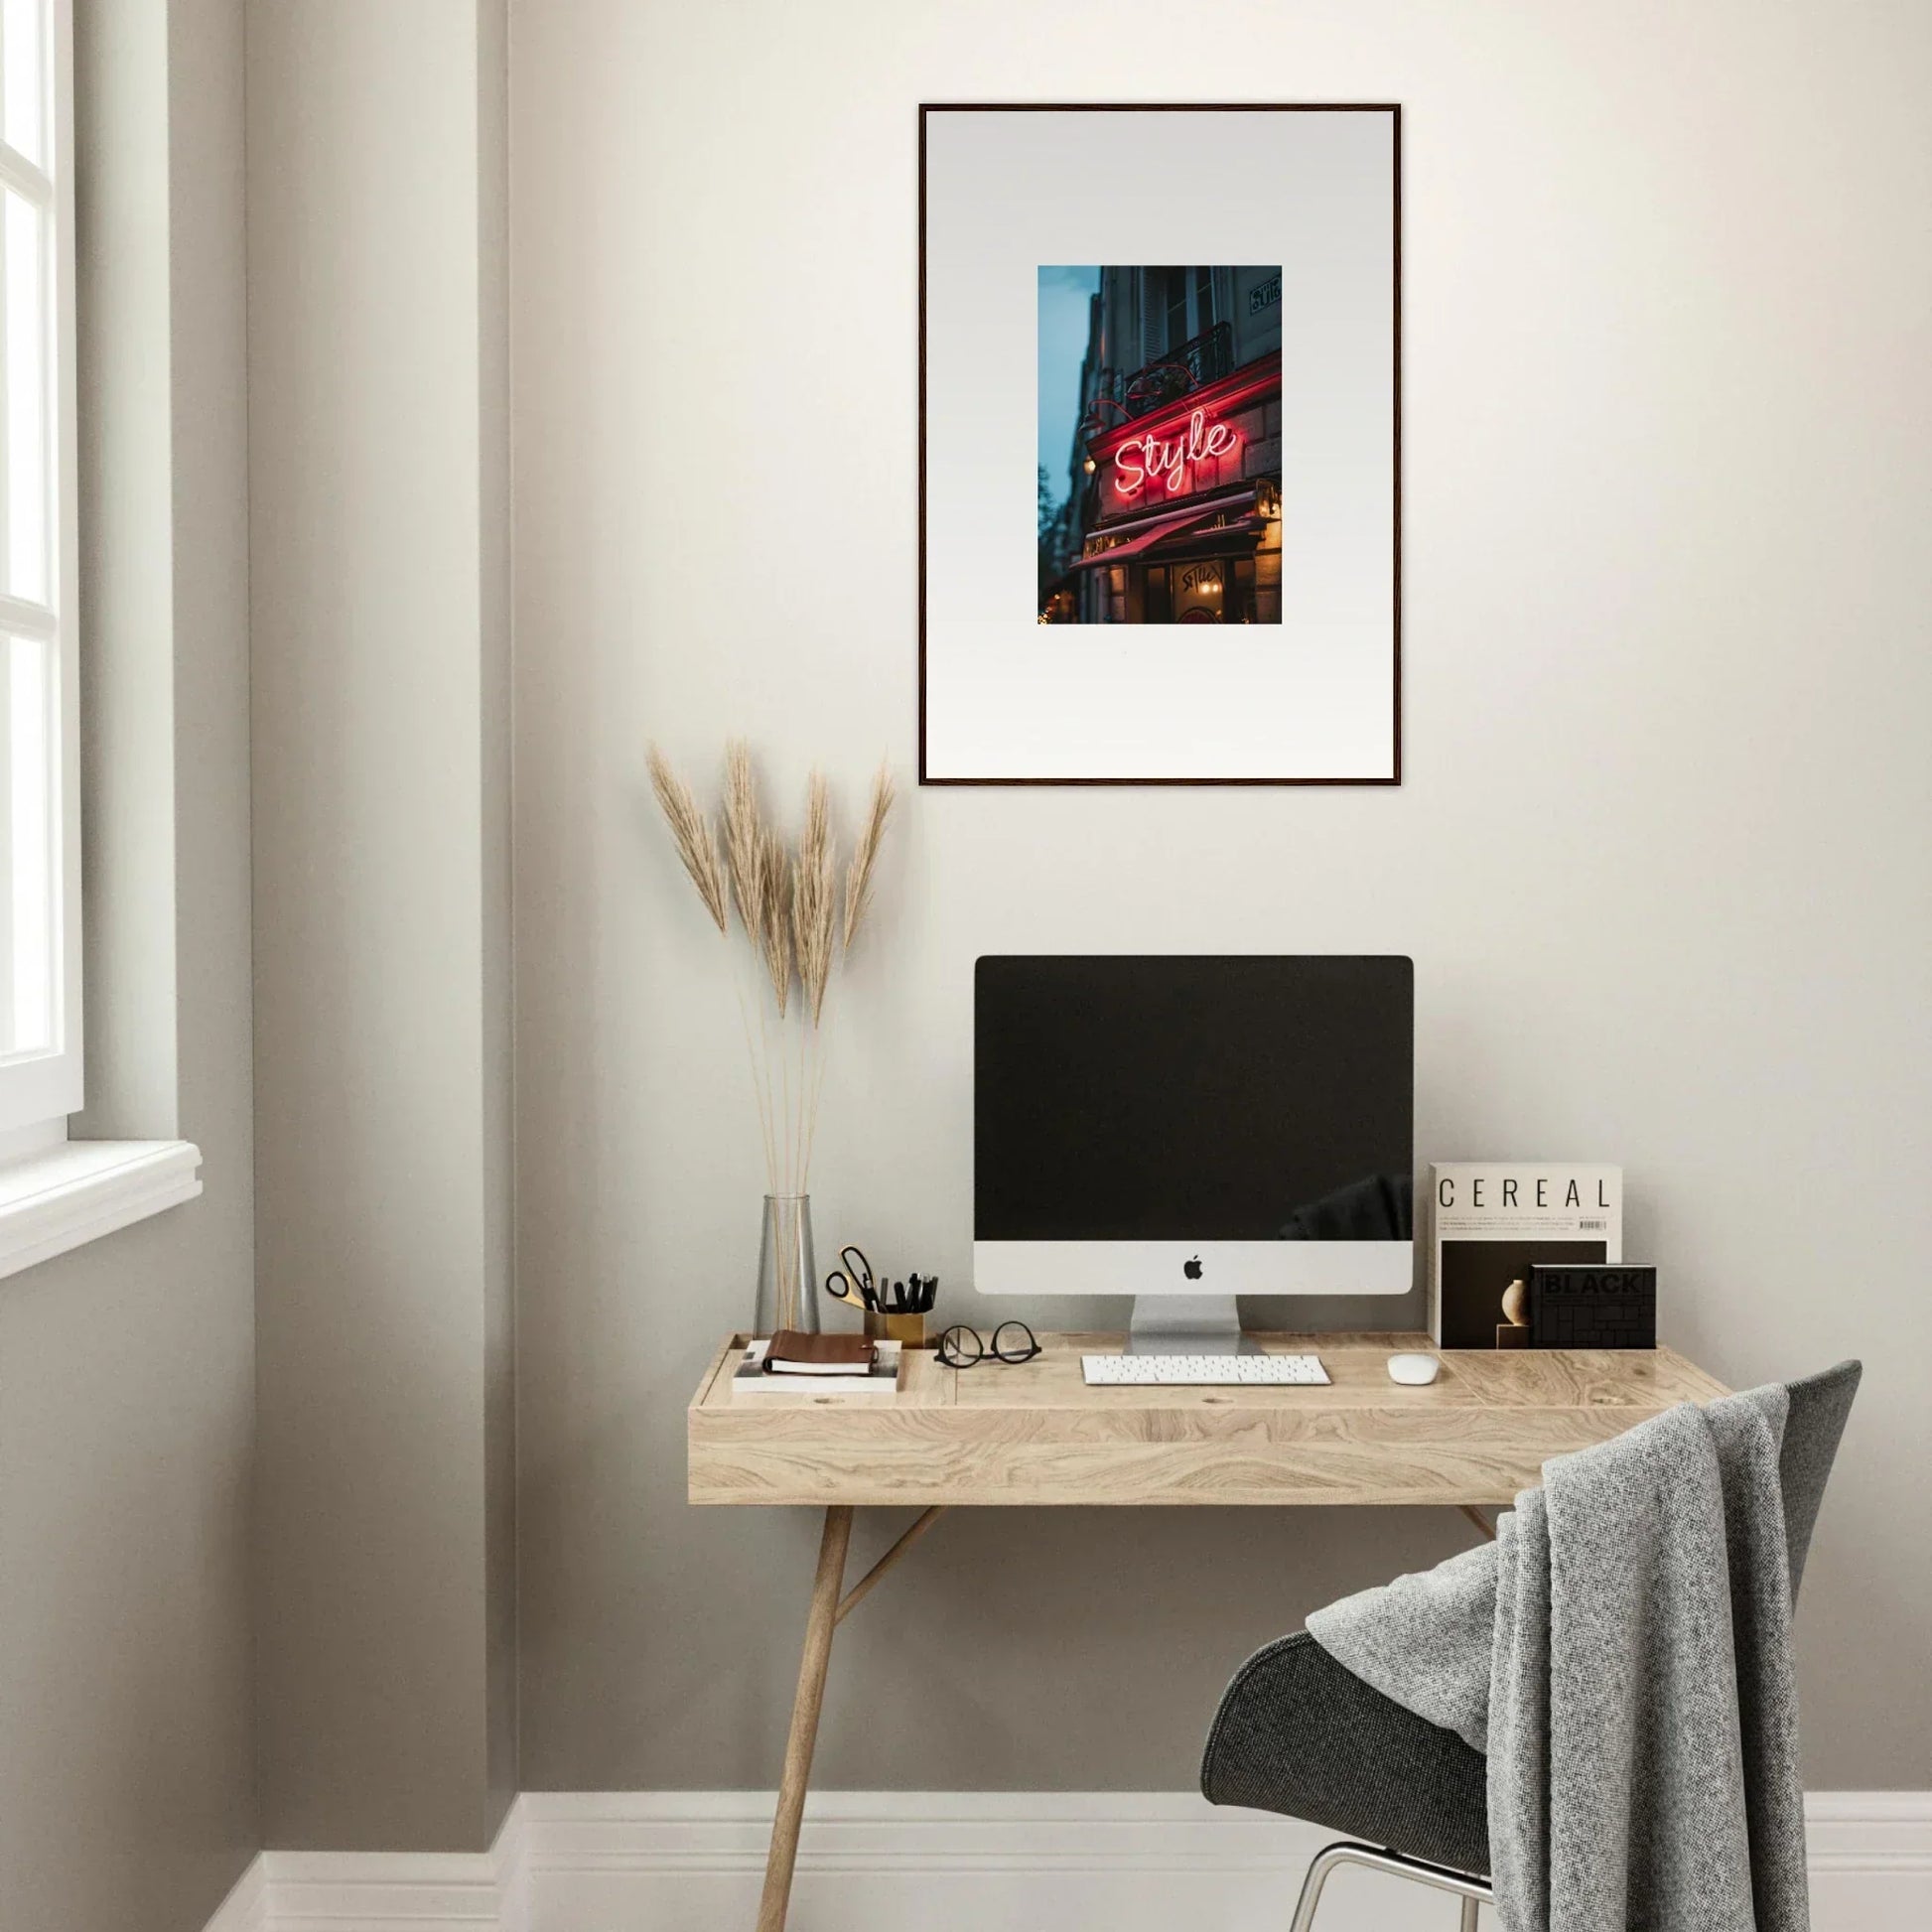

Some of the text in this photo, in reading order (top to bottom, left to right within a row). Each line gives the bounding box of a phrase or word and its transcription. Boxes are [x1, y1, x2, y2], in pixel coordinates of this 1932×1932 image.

[1114, 408, 1237, 492] Style
[1439, 1177, 1610, 1208] CEREAL
[1544, 1273, 1641, 1295] BLACK
